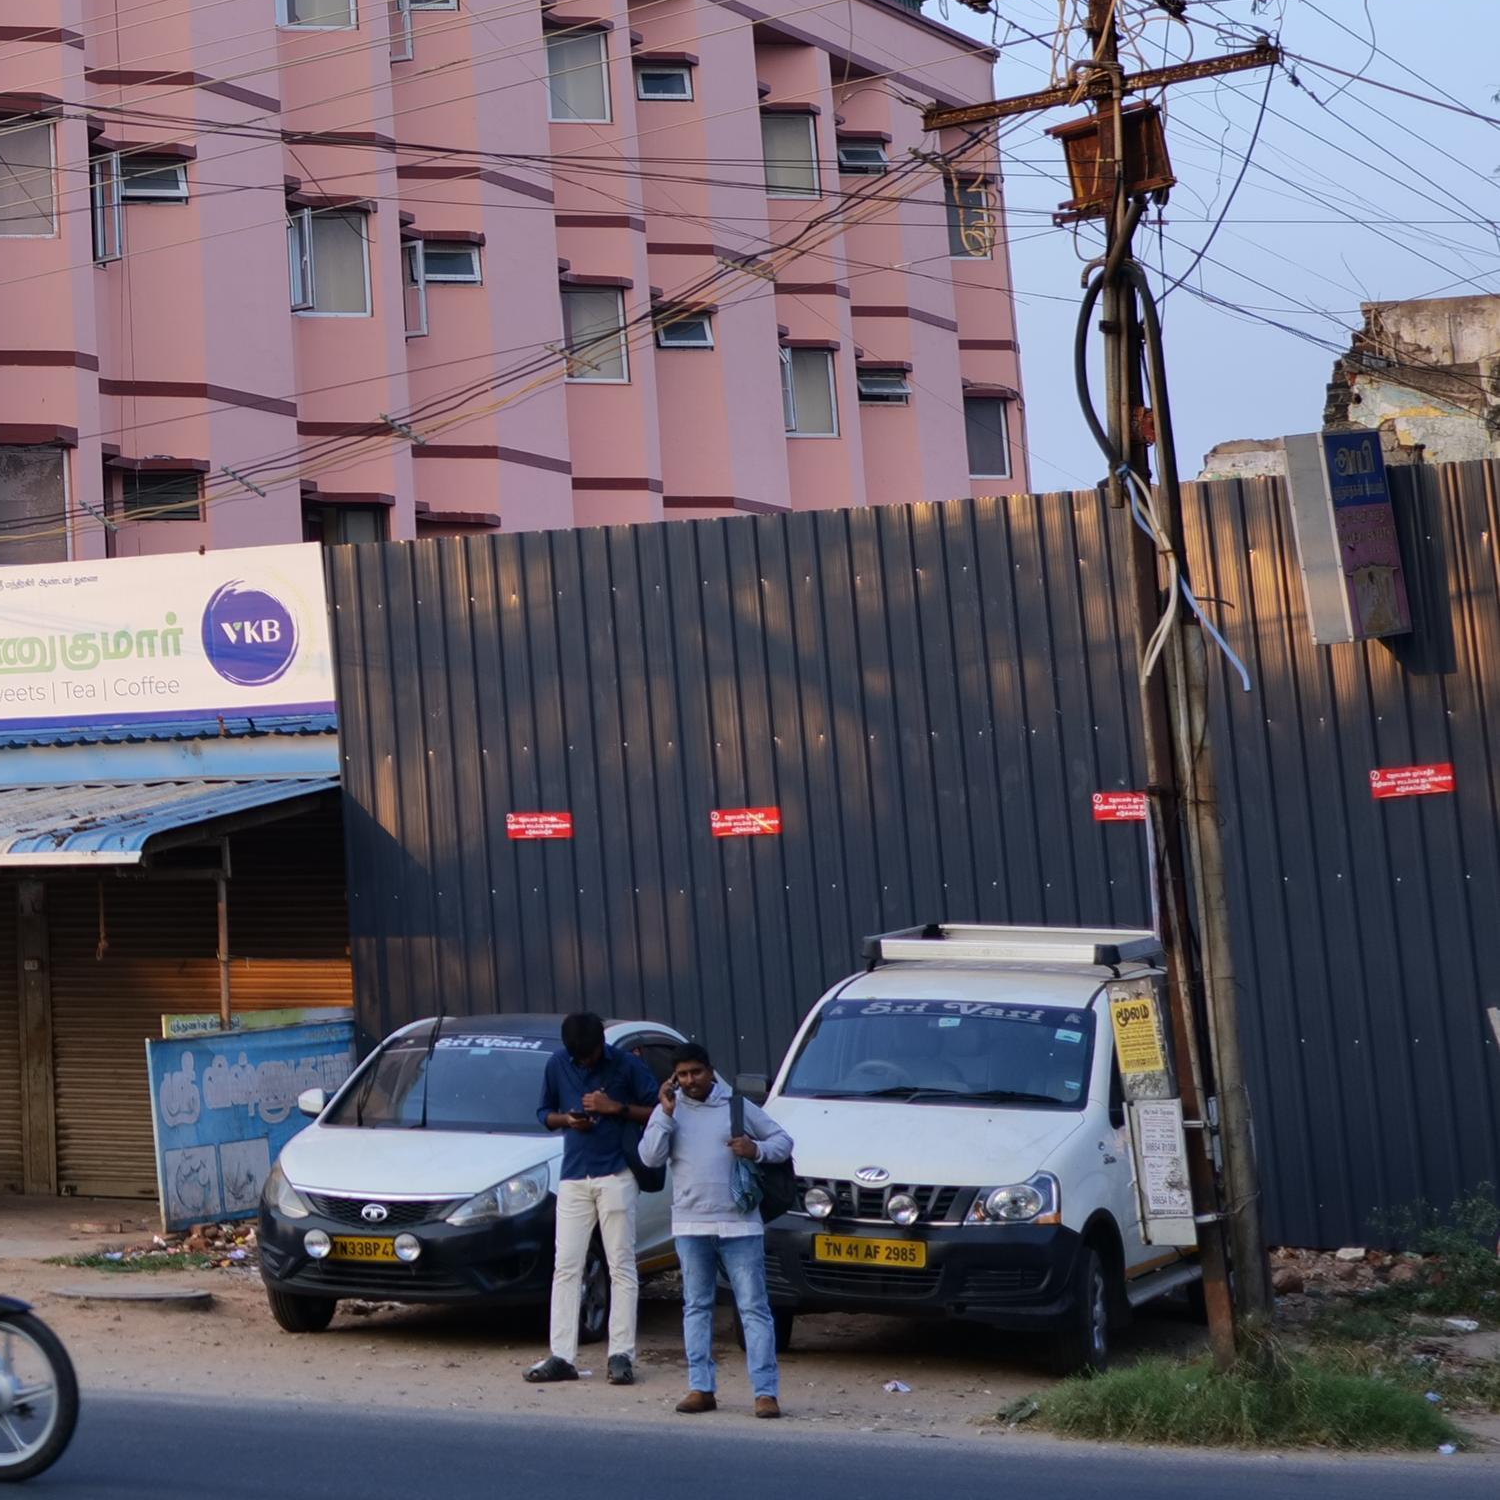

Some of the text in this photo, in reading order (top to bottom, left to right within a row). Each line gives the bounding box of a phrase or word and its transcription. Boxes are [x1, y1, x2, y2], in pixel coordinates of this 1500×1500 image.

[220, 619, 282, 645] VKB
[61, 677, 97, 700] Tea
[113, 674, 181, 698] Coffee
[860, 1001, 1046, 1021] Sri Vari
[825, 1237, 917, 1263] TN 41 AF 2985
